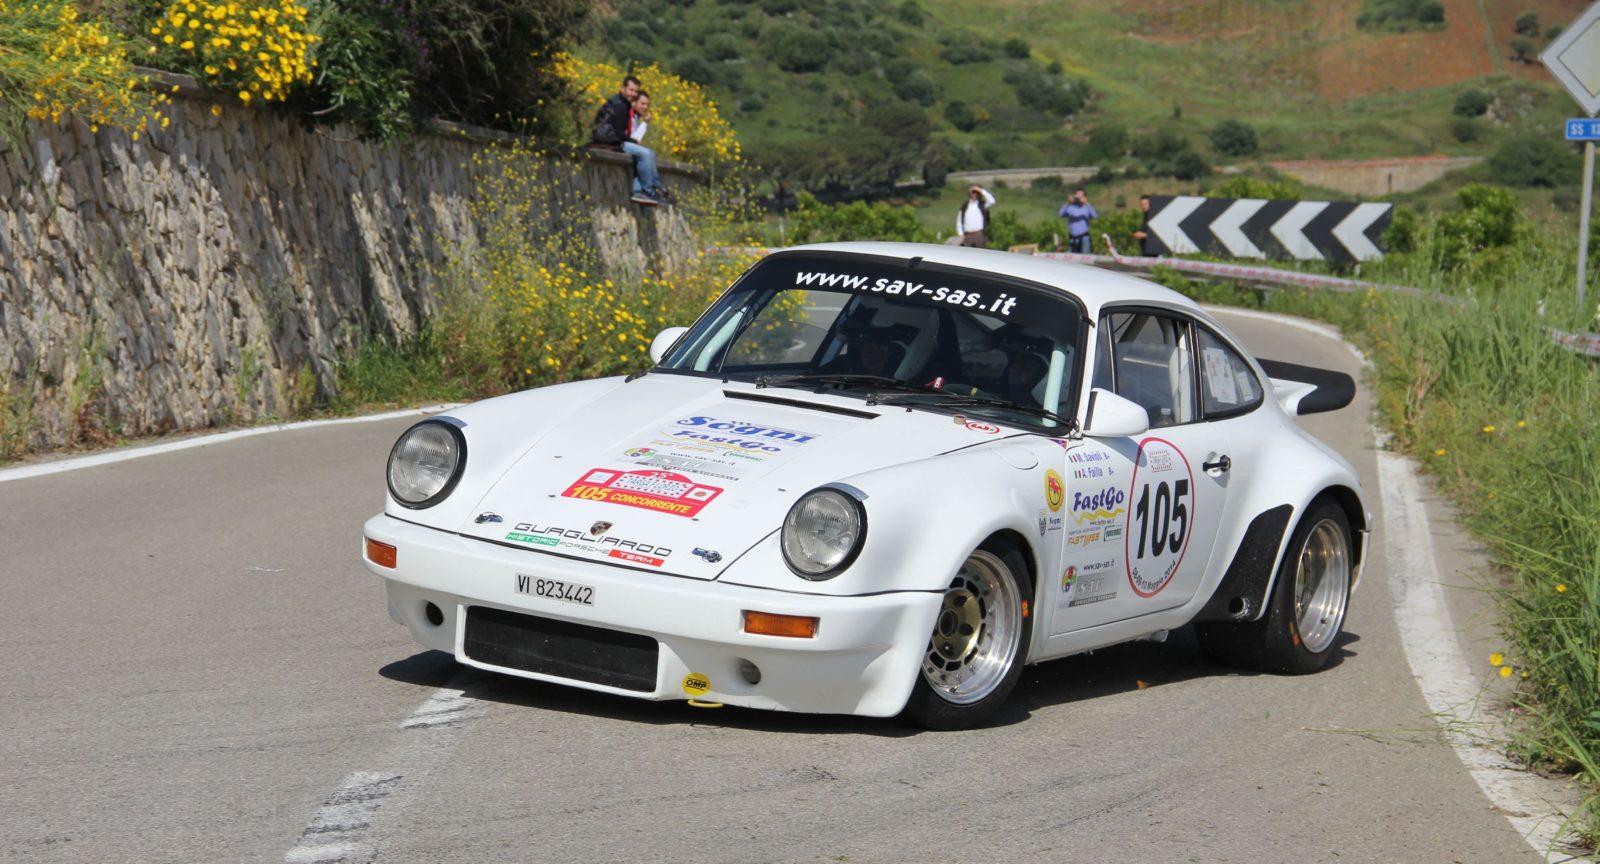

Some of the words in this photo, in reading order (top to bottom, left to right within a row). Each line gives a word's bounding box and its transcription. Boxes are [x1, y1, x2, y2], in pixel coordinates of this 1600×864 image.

[1570, 122, 1584, 136] SS
[795, 271, 1017, 316] www.sav-sas.it
[673, 430, 781, 452] FastGo
[676, 416, 815, 445] Sogni
[572, 485, 611, 501] 105
[610, 493, 692, 514] CONCORRENTE
[1073, 487, 1124, 512] FastGo
[1136, 479, 1188, 559] 105
[506, 532, 560, 547] HISTORIC
[557, 541, 610, 555] PORSCHE
[618, 552, 656, 565] TEAM
[514, 522, 672, 557] GUAGLIARDO
[518, 574, 530, 594] VI
[536, 578, 593, 605] 823442
[686, 679, 707, 688] OMP
